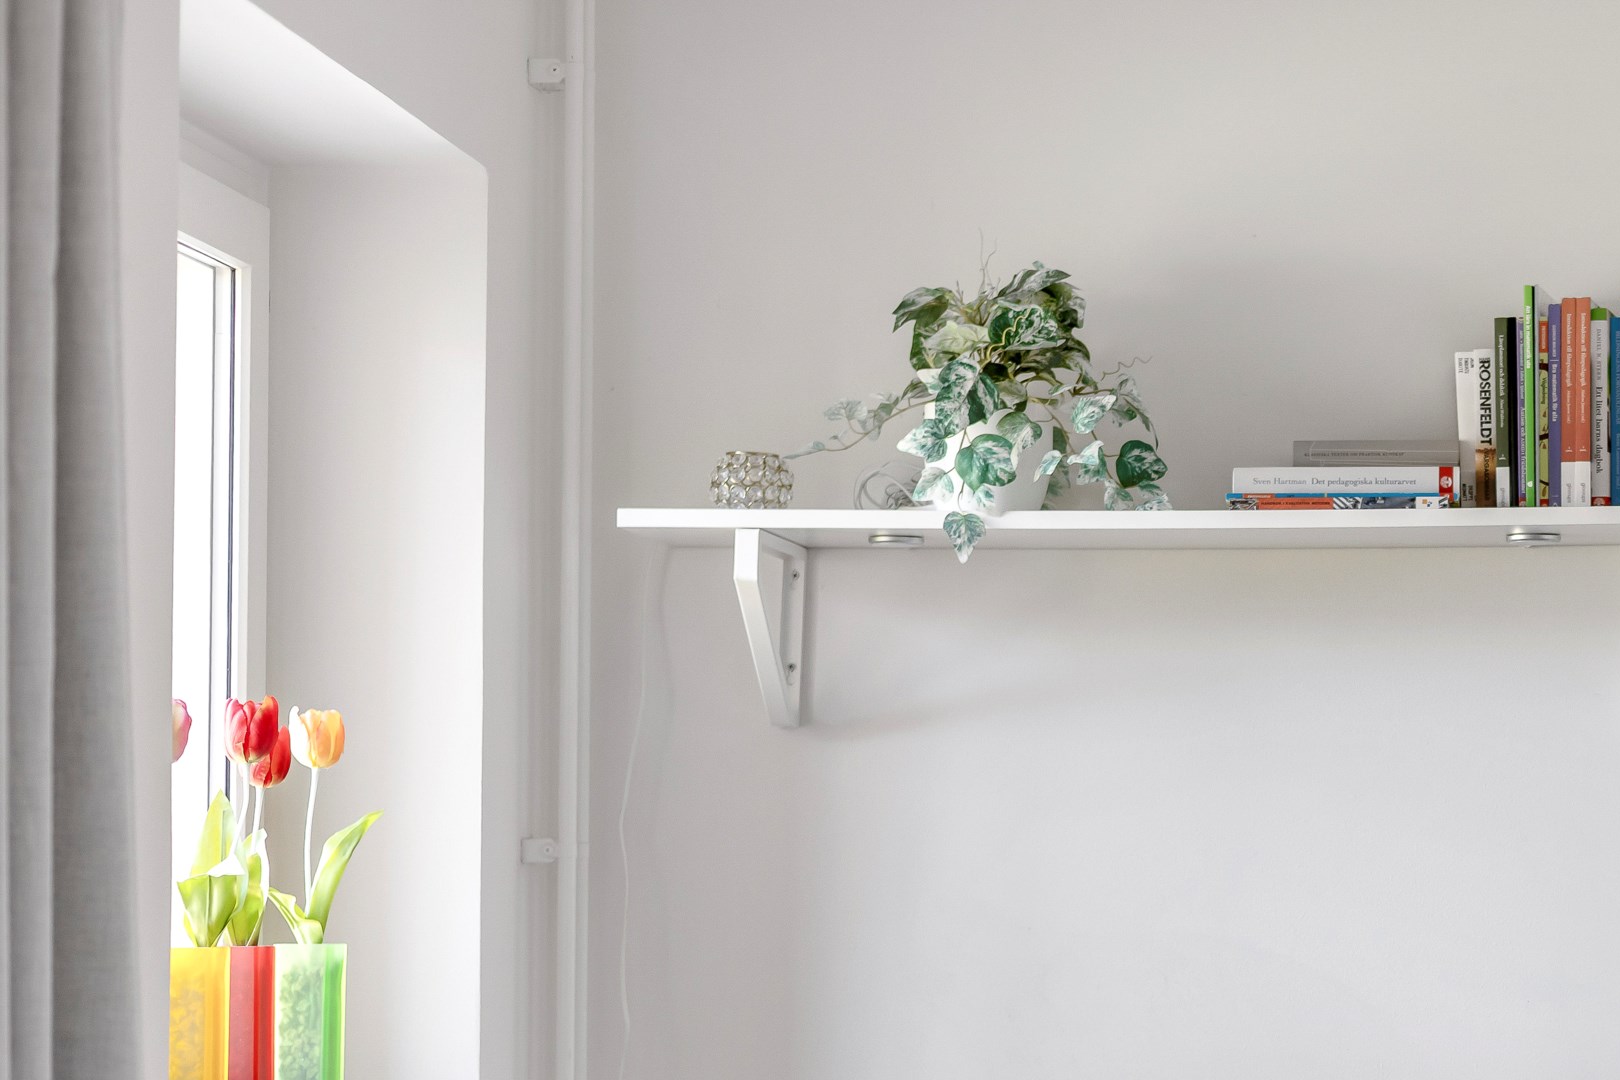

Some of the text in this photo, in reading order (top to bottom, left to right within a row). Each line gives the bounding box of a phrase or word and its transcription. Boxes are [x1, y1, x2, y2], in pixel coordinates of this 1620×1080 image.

[1479, 360, 1492, 445] ROSENFELDT
[1594, 444, 1603, 474] dagbok
[1252, 477, 1416, 489] Sven Hartman Det pedagogiska kulturarvet
